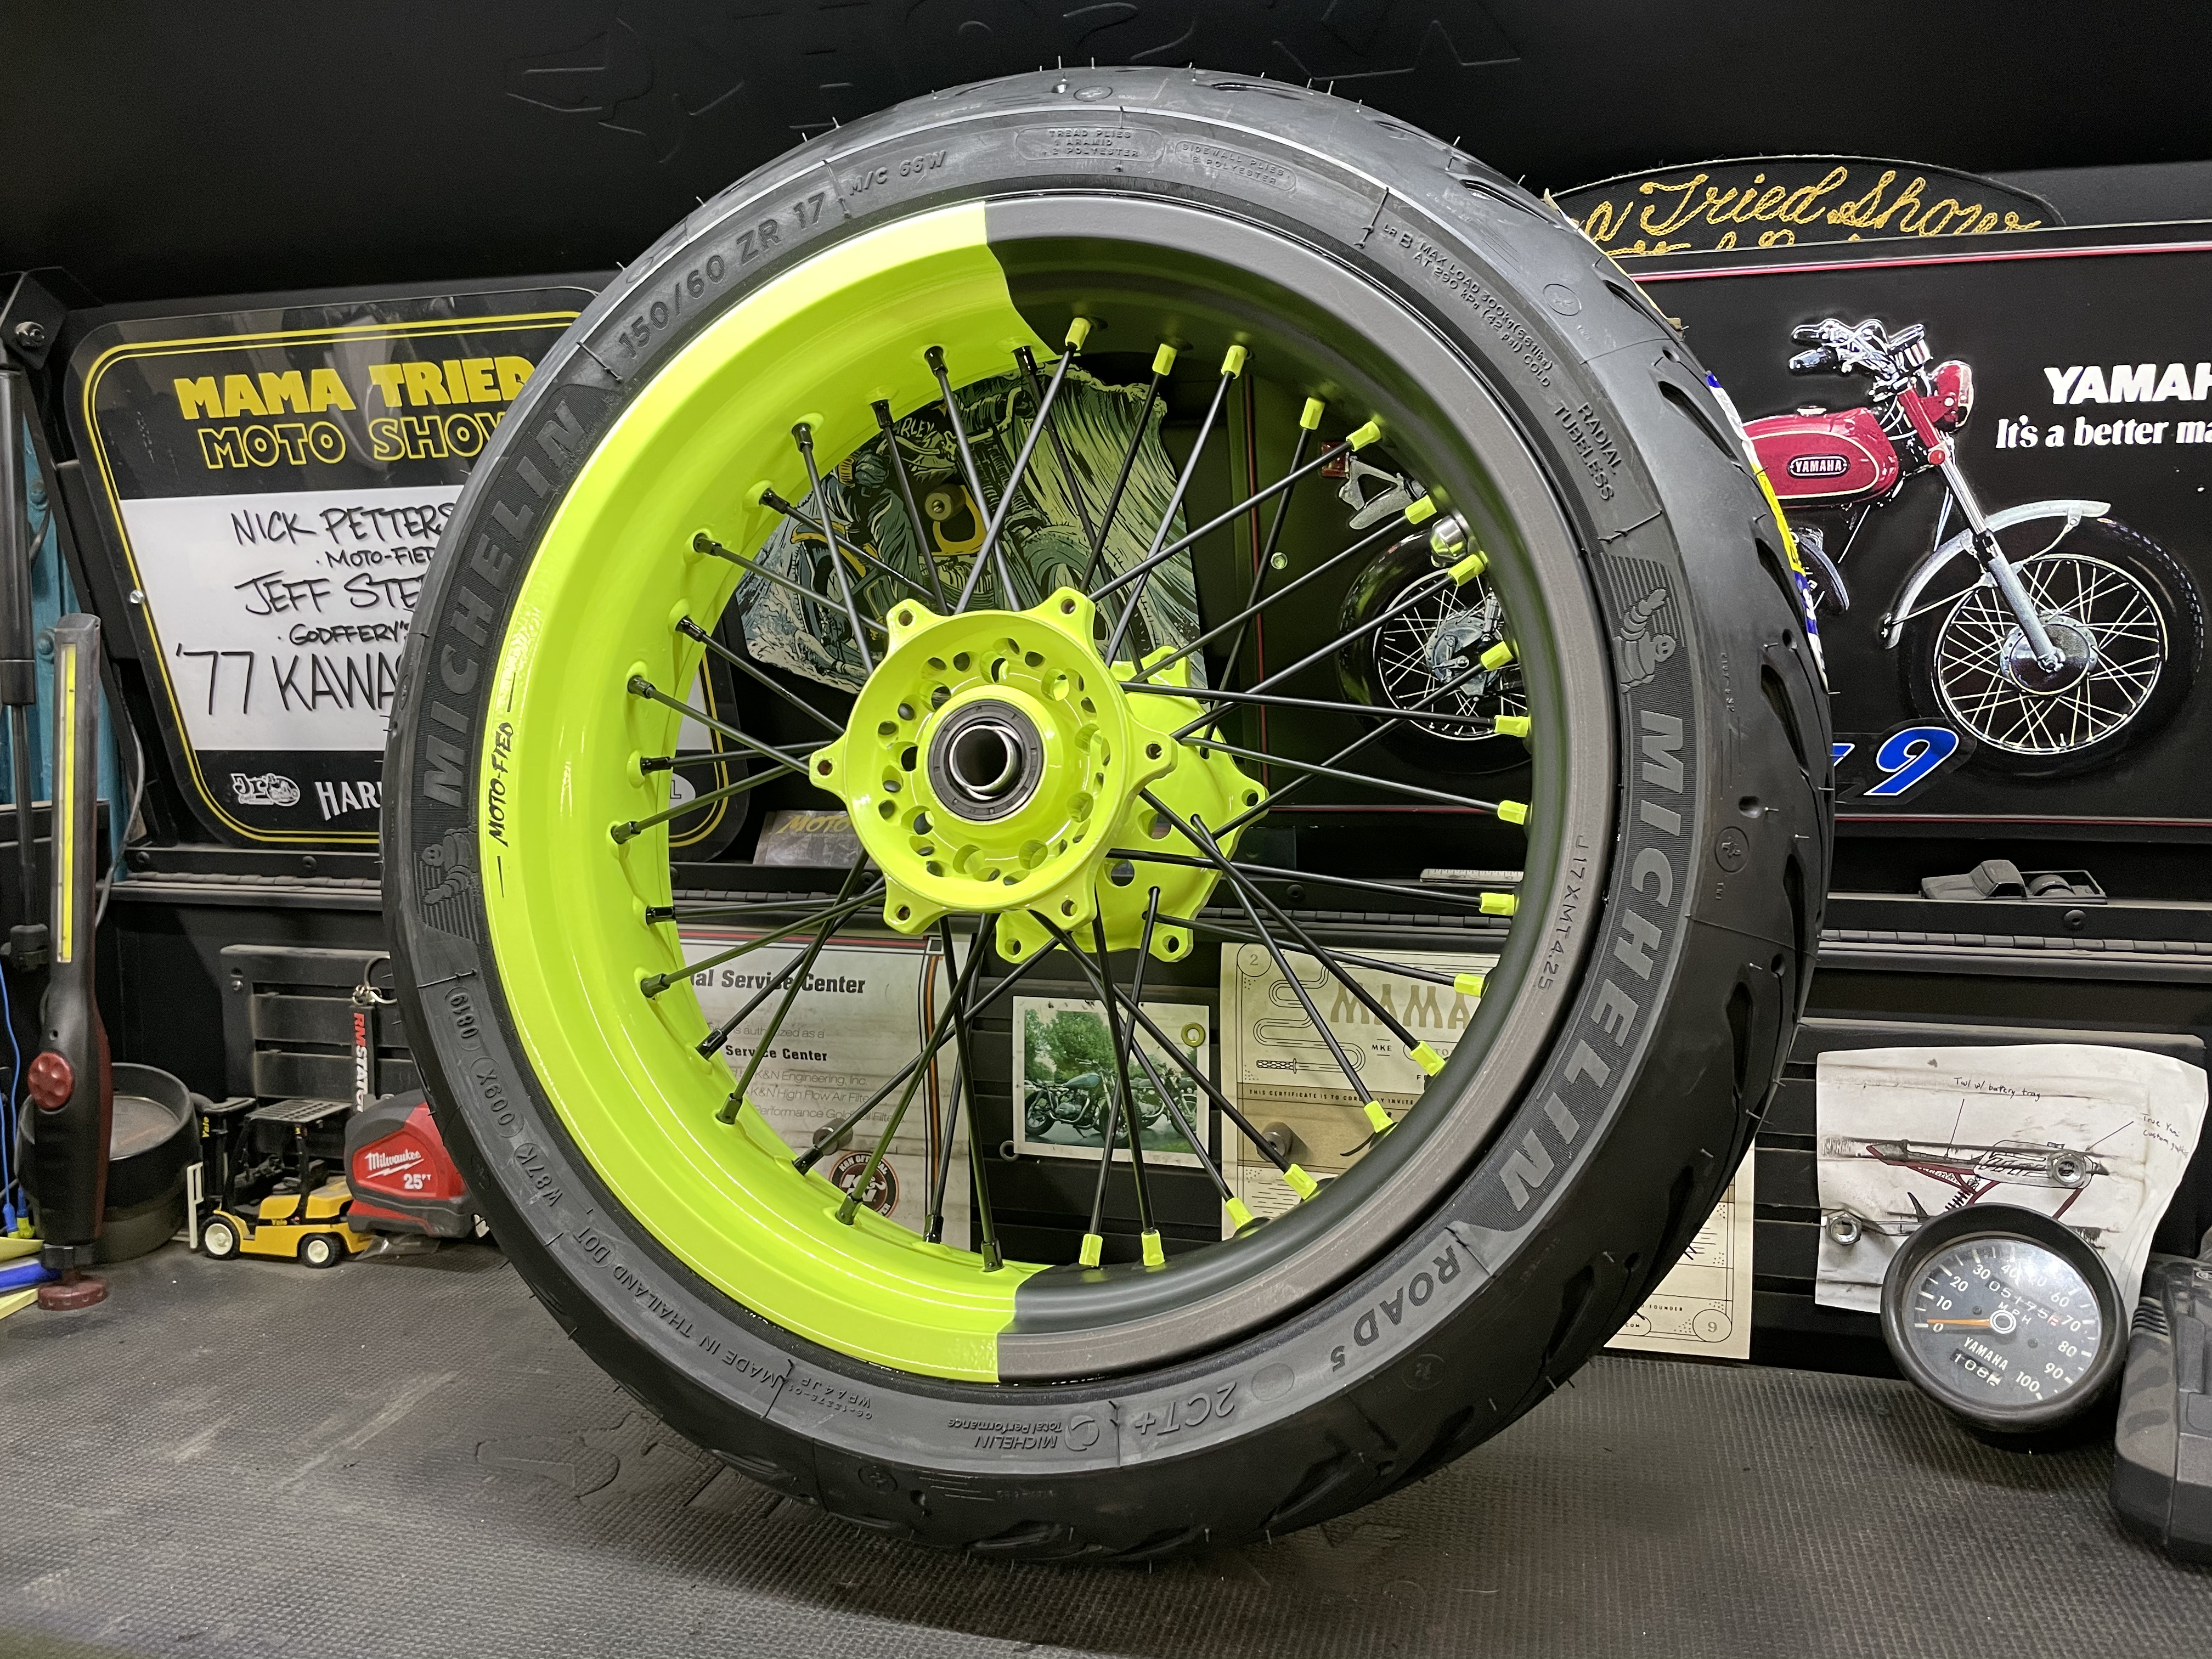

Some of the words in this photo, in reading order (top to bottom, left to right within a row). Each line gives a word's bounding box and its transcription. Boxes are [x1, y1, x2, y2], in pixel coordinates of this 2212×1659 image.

[1049, 129, 1088, 137] TREAD
[1097, 129, 1131, 138] PLIES
[1066, 148, 1139, 157] POLYESTER
[1182, 144, 1242, 163] SIDEWALL
[1250, 160, 1284, 176] PLIES
[849, 166, 889, 196] M/C
[899, 150, 948, 177] 66W
[1206, 159, 1277, 185] POLYESTER
[1639, 166, 1826, 236] Tried
[1400, 231, 1413, 249] B
[1418, 240, 1448, 266] MAX
[1449, 263, 1480, 294] LOAD
[617, 253, 726, 359] 150/60
[736, 219, 782, 266] ZR
[793, 192, 825, 230] 17
[1413, 251, 1433, 267] AT
[1434, 266, 1459, 290] 290
[1460, 289, 1480, 310] kPa
[1523, 353, 1551, 388] COLD
[174, 369, 357, 421] MAMA
[368, 356, 538, 407] TRIED
[1578, 402, 1623, 476] RADIAL
[1996, 414, 2039, 449] It's
[2045, 425, 2065, 448] a
[2074, 416, 2170, 447] better
[199, 421, 347, 470] MOTO
[1554, 400, 1615, 501] TUBELESS
[1796, 460, 1842, 472] YAMAHA
[231, 510, 317, 546] NICK
[234, 570, 331, 615] JEFF
[423, 400, 585, 808] MICHELIN
[176, 643, 256, 715] '77
[272, 652, 402, 712] KAWA
[488, 721, 515, 848] MOTO-FIED
[314, 781, 382, 821] HAR
[1250, 953, 1259, 966] 2
[1498, 709, 1683, 1212] MICHELIN
[721, 969, 794, 991] Servie
[803, 973, 866, 994] Center
[450, 992, 479, 1039] 0819
[1330, 982, 1471, 1030] MAMA
[743, 1025, 800, 1038] authized
[803, 1030, 816, 1038] as
[817, 1030, 825, 1039] a
[725, 1045, 777, 1059] Servce
[782, 1048, 827, 1062] Center
[1372, 1043, 1392, 1052] MKE
[754, 1069, 780, 1080] K&N
[850, 1075, 867, 1085] Inc.
[751, 1086, 776, 1098] K&N
[777, 1088, 802, 1101] High
[804, 1090, 831, 1101] Flow
[832, 1092, 847, 1102] Air
[849, 1092, 870, 1103] Filte
[1269, 1090, 1318, 1099] CERTIFICATE
[1989, 1084, 2016, 1099] battery
[2022, 1087, 2040, 1102] tray
[754, 1104, 824, 1118] Performance
[873, 1111, 905, 1123] Filtes
[365, 1149, 421, 1171] Milwaukee
[839, 1157, 854, 1172] K&N
[855, 1155, 888, 1175] OFFIAL
[516, 1144, 563, 1207] W87K
[573, 1227, 611, 1264] DOT
[1949, 1276, 1968, 1291] 20
[1973, 1265, 1991, 1279] 30
[612, 1264, 693, 1339] THAILAND
[1350, 1244, 1462, 1348] ROAD
[1649, 1304, 1683, 1312] FOUNDER
[1936, 1295, 1953, 1311] 10
[2051, 1292, 2070, 1307] 60
[1998, 1301, 2032, 1325] MPH
[2061, 1315, 2081, 1332] 70
[1707, 1321, 1718, 1333] 9
[1933, 1323, 1944, 1333] 0
[699, 1335, 721, 1356] IN
[1329, 1344, 1347, 1370] 5
[1963, 1336, 2008, 1370] YAMAHA
[2058, 1341, 2078, 1357] 80
[721, 1348, 787, 1389] MADE
[2044, 1363, 2064, 1379] 90
[2015, 1372, 2040, 1392] 100
[1133, 1380, 1238, 1436] 2CT+
[947, 1418, 1031, 1435] Performance
[1032, 1421, 1063, 1435] Total
[974, 1435, 1058, 1450] MICHELIN
